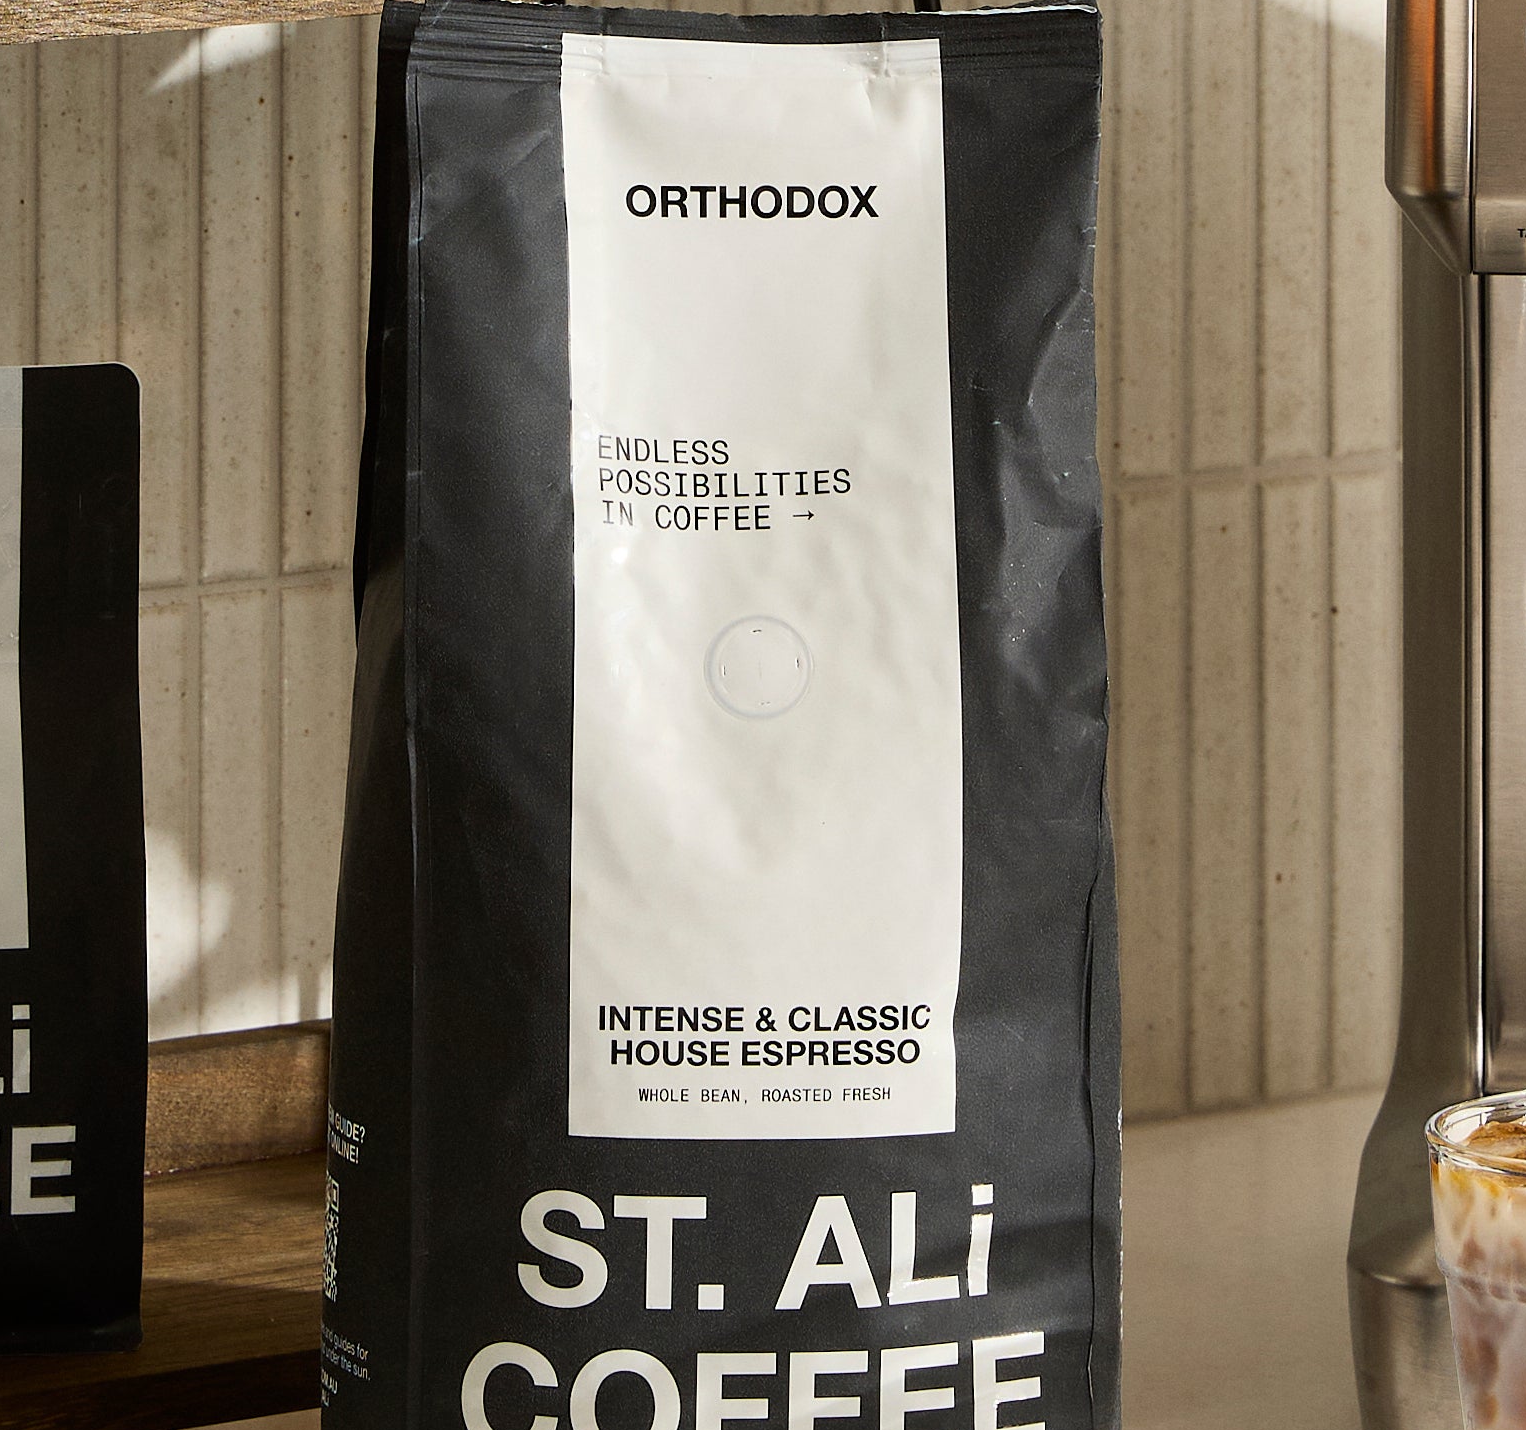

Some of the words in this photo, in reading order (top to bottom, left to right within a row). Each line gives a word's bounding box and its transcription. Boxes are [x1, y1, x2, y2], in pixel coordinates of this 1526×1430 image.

[626, 185, 878, 218] ORTHODOX
[597, 435, 730, 465] ENDLESS
[598, 468, 852, 499] POSSIBILITIES
[601, 500, 634, 527] IN
[656, 505, 770, 530] COFFEE
[599, 1006, 744, 1032] INTENSE
[756, 1007, 777, 1032] &
[789, 1005, 930, 1031] CLASSIC
[611, 1040, 729, 1066] HOUSE
[742, 1039, 920, 1066] ESPRESSO
[639, 1089, 688, 1102] WHOLE
[700, 1088, 748, 1105] BEAN,
[762, 1089, 832, 1102] ROASTED
[843, 1087, 890, 1101] FRESH
[518, 1190, 724, 1310] ST.
[776, 1184, 993, 1309] ALi
[357, 1343, 368, 1360] for
[341, 1354, 352, 1372] the
[353, 1364, 370, 1381] sun.
